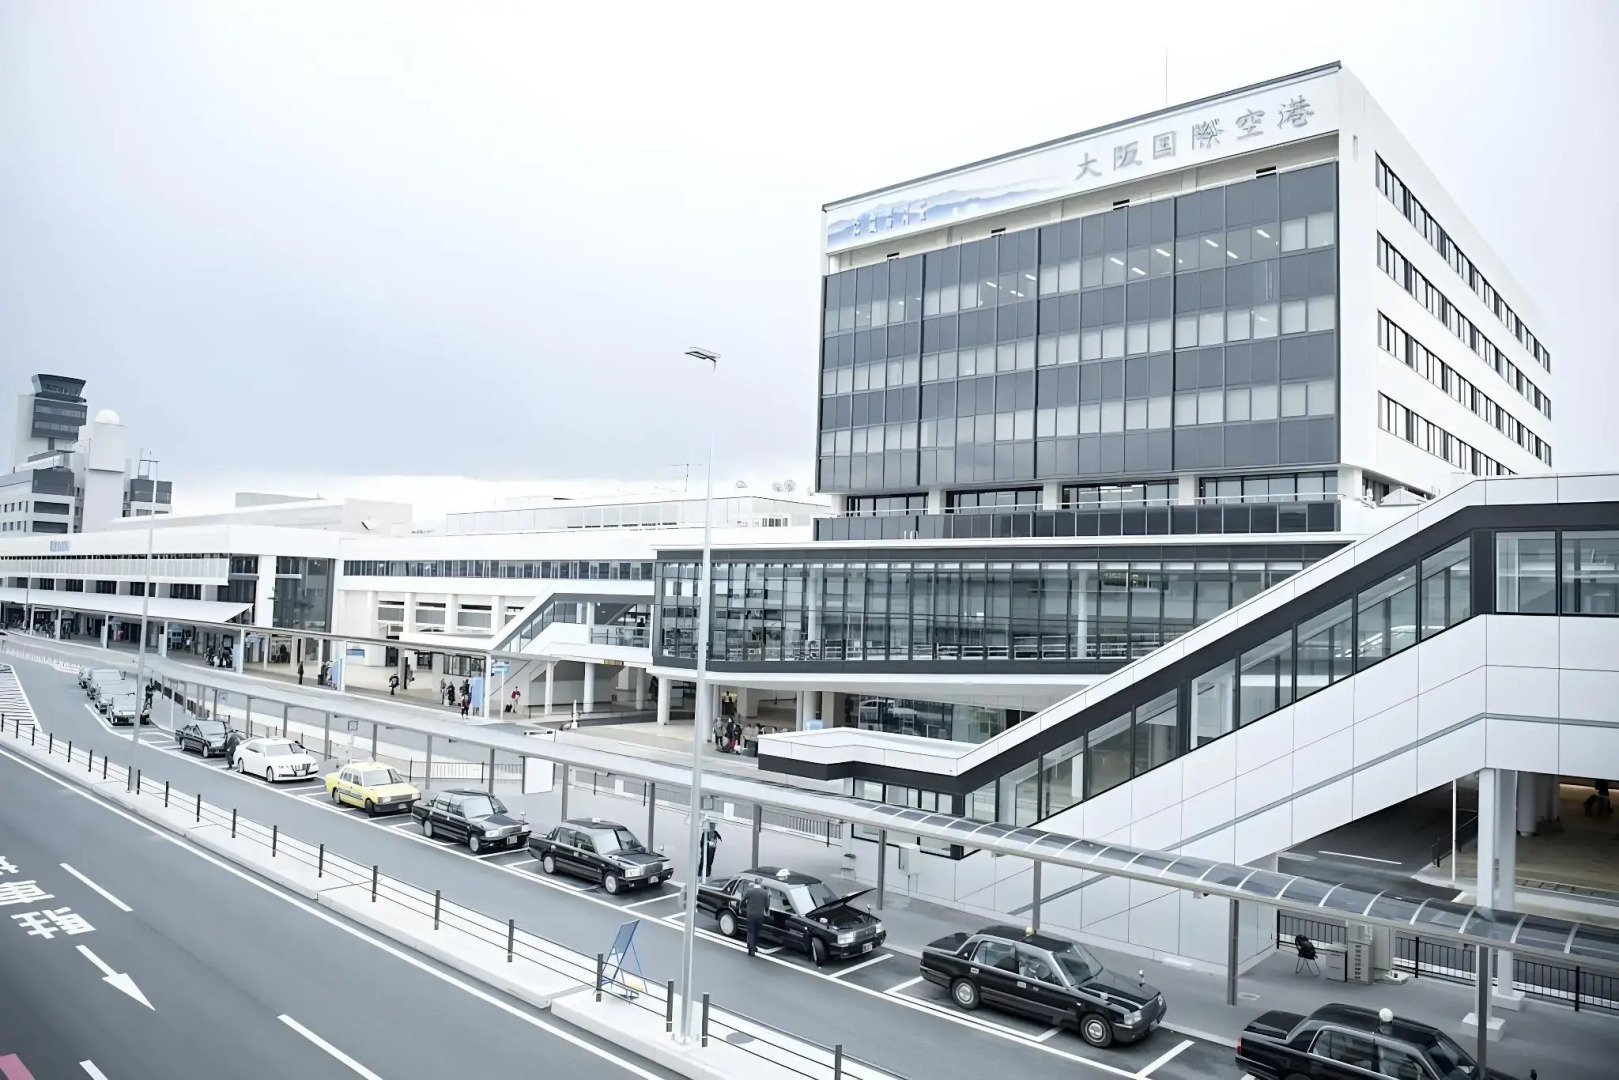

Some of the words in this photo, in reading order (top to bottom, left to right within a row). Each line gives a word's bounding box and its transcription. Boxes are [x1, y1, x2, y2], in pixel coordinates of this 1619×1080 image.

[1075, 95, 1314, 180] 大阪国際空港
